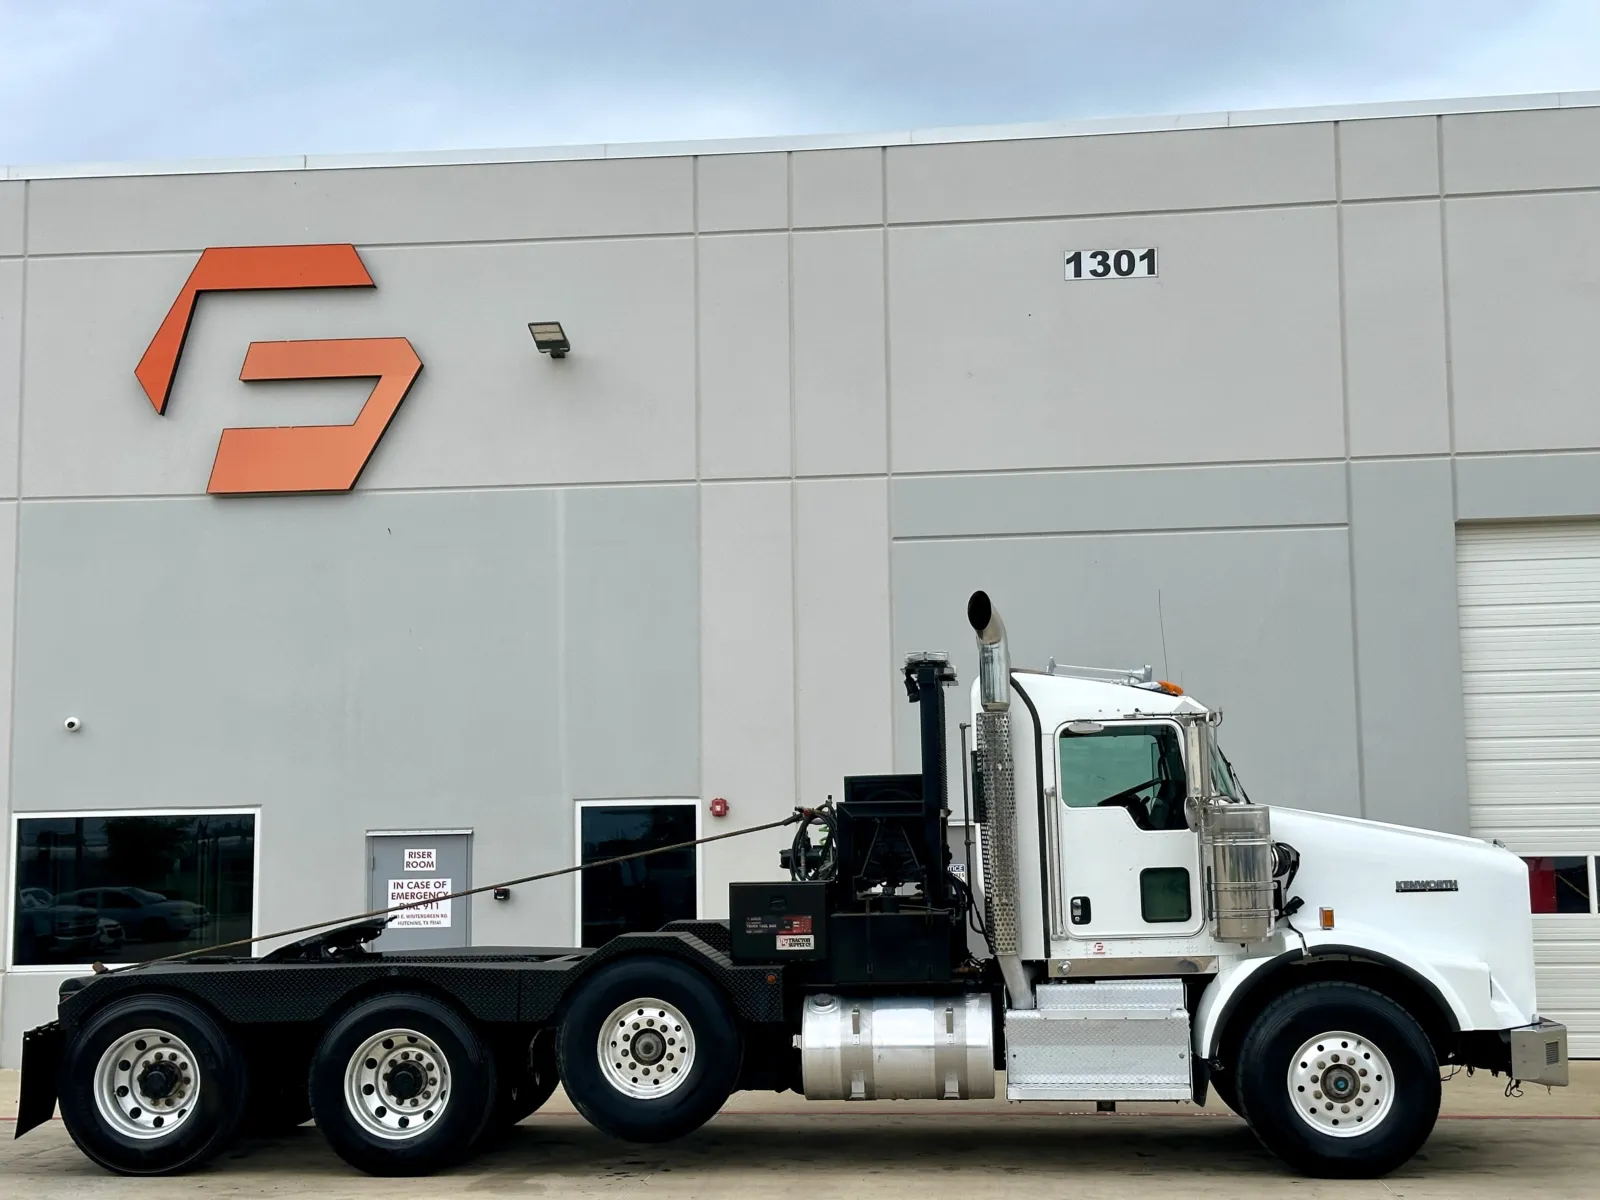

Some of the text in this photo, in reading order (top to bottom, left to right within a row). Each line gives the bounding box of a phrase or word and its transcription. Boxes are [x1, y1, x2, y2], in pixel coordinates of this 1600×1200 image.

[1065, 248, 1156, 278] 1301
[408, 851, 432, 859] RISER
[405, 860, 435, 869] ROOM
[393, 880, 447, 890] IN CASE OF
[1395, 880, 1458, 890] KENWORTH
[391, 891, 449, 900] EMERGENCY
[424, 902, 439, 910] 911
